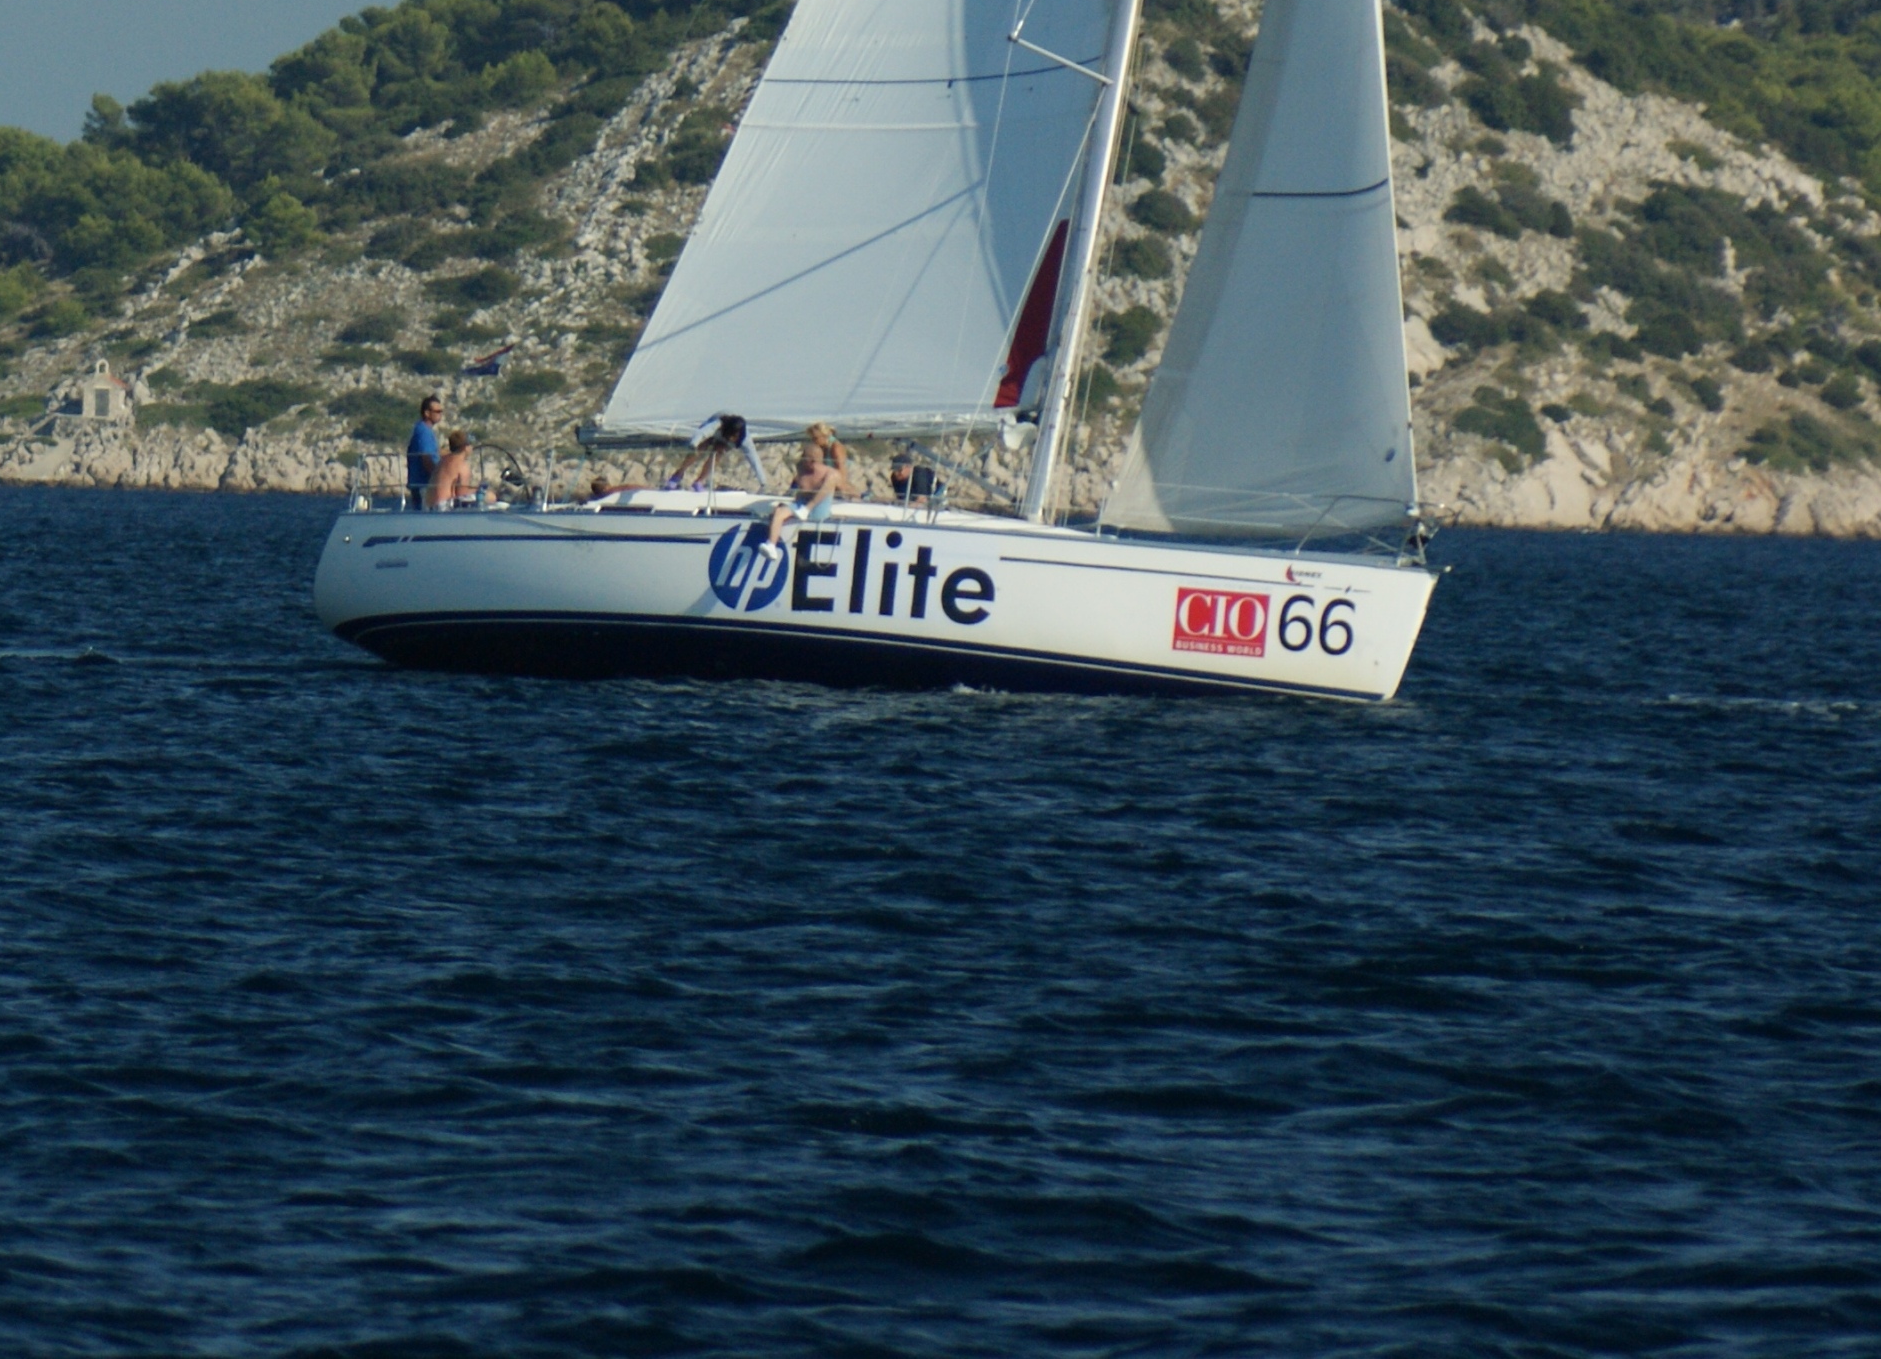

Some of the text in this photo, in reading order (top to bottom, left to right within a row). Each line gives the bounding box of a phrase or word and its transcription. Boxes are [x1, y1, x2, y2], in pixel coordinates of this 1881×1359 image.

[712, 522, 996, 625] hp Elite
[1178, 592, 1266, 640] CIO
[1278, 594, 1356, 656] 66
[1175, 640, 1263, 657] BUSINESS WORLD
